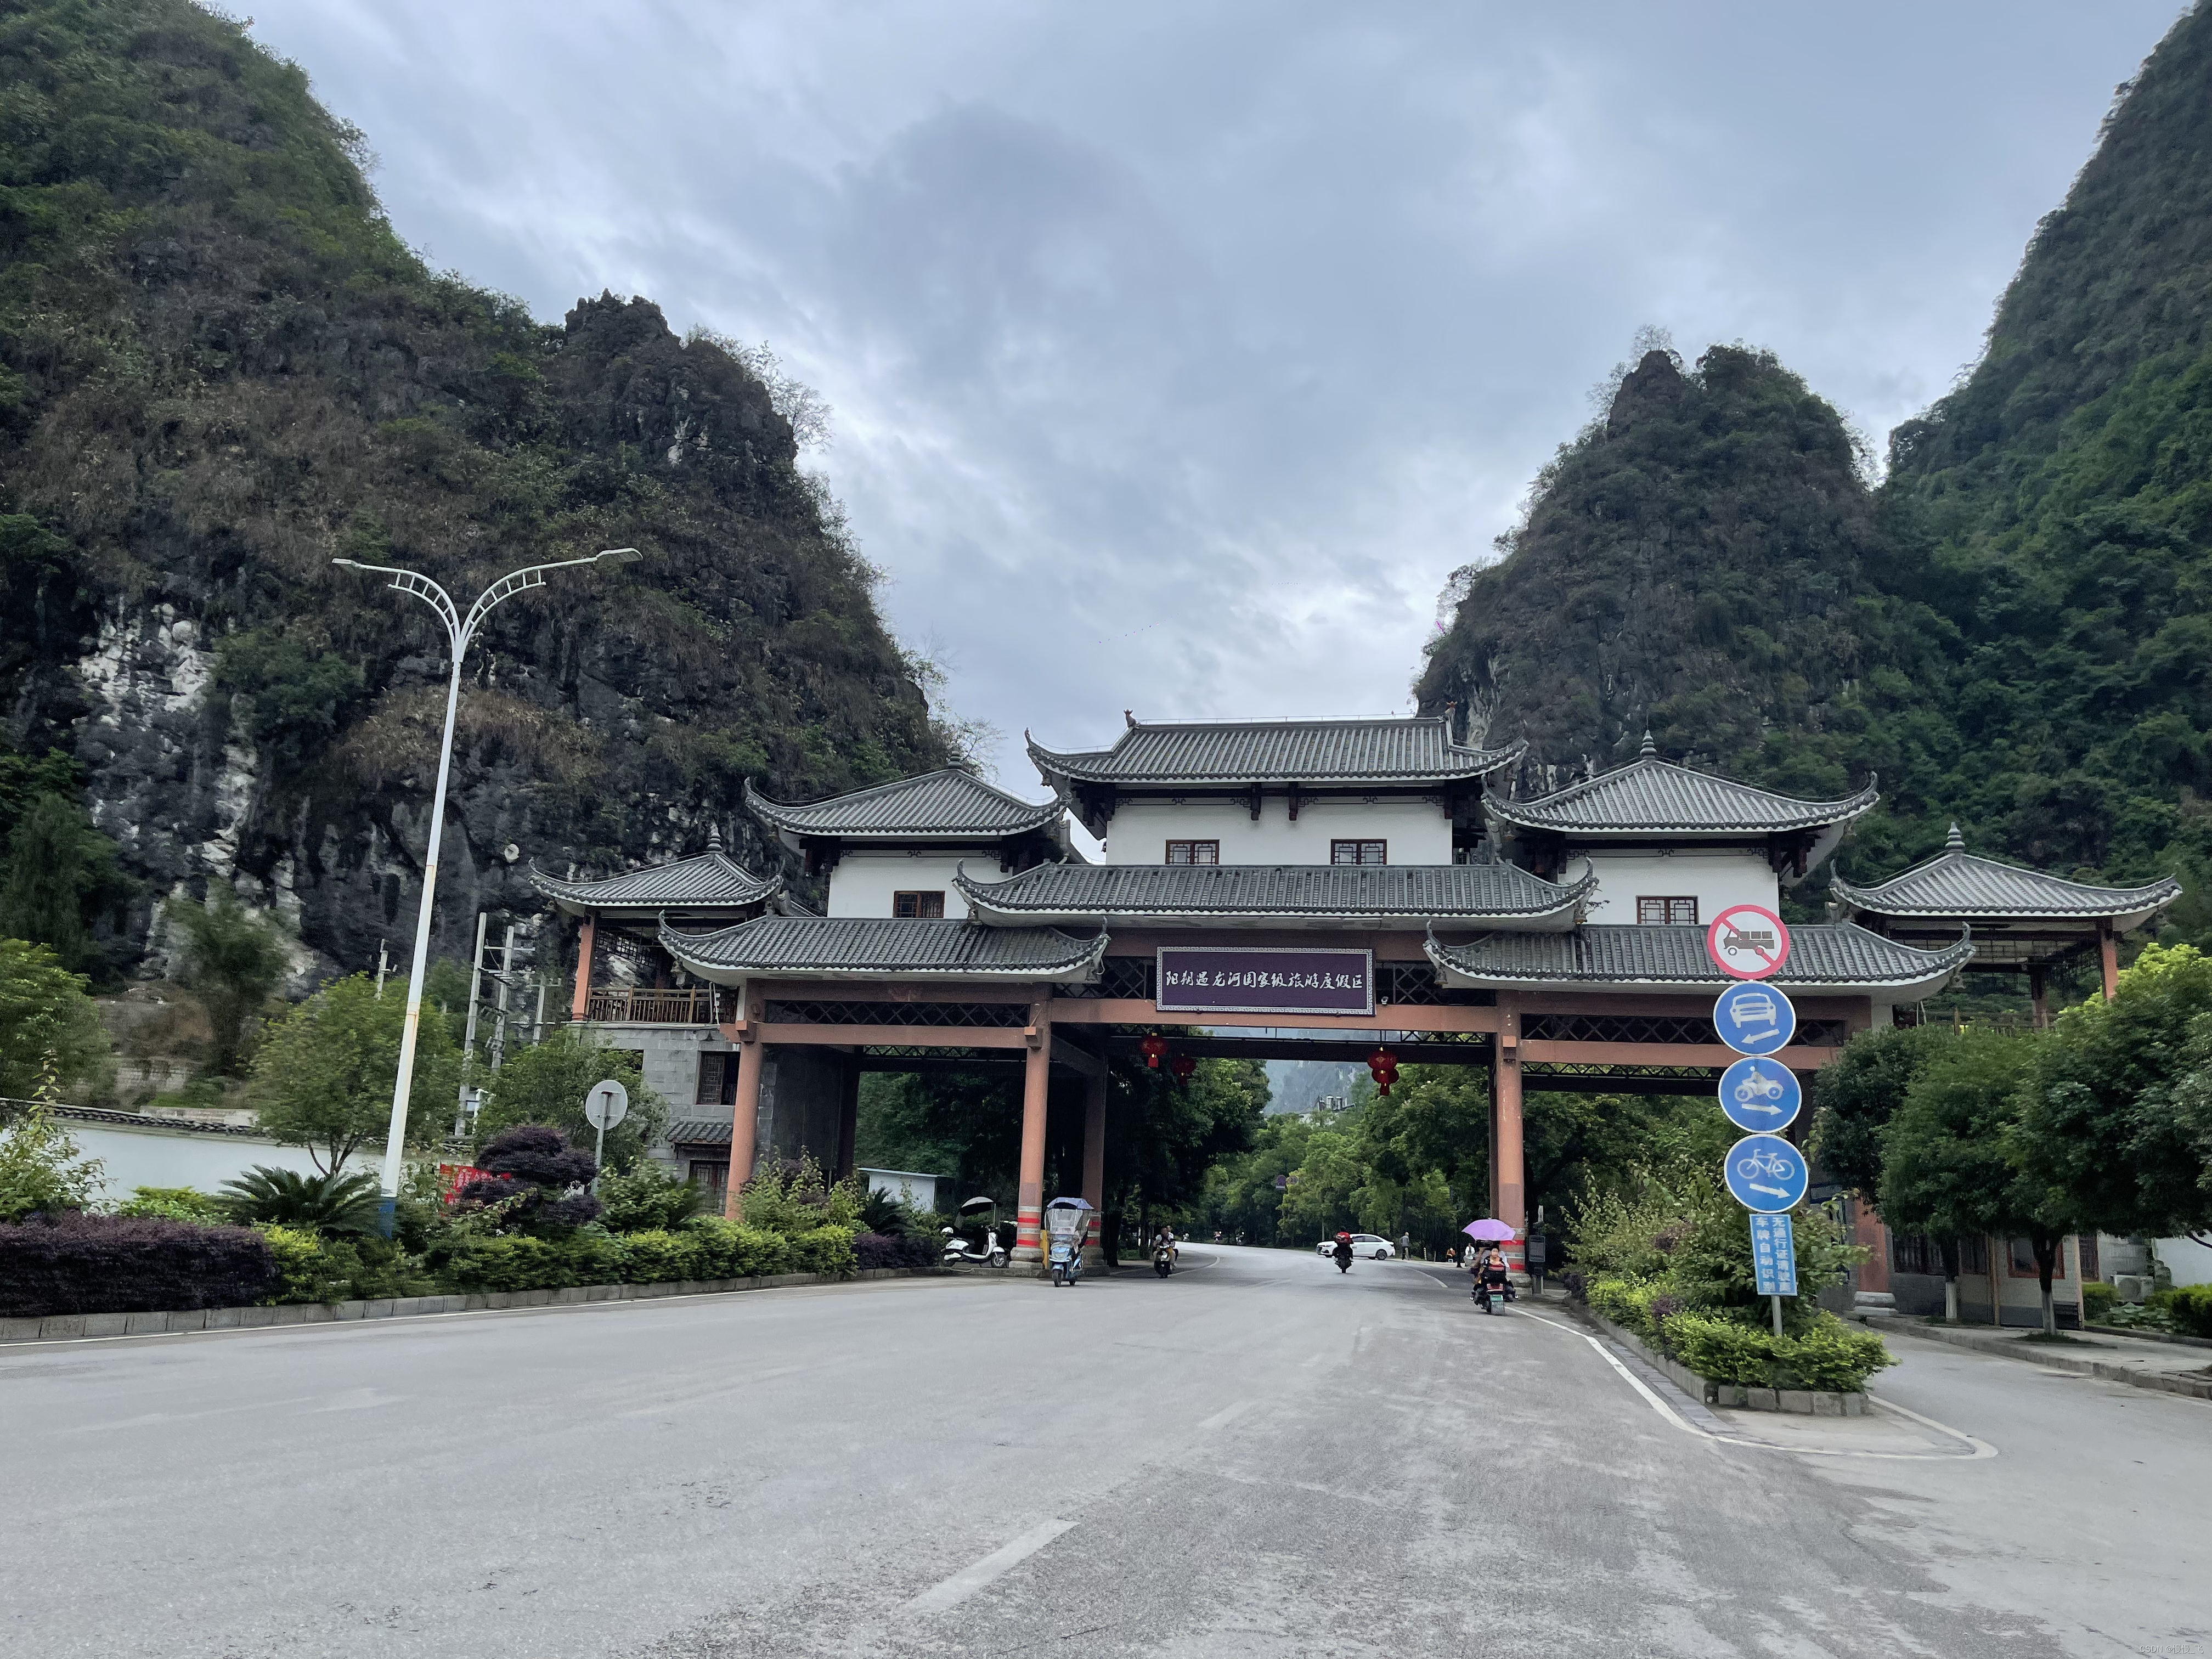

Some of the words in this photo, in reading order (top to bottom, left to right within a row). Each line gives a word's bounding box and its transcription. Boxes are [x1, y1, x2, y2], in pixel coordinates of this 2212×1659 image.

[1165, 970, 1363, 989] 阳朔遇龙河国家级旅游度假区
[1755, 1216, 1776, 1291] 车牌自动识别
